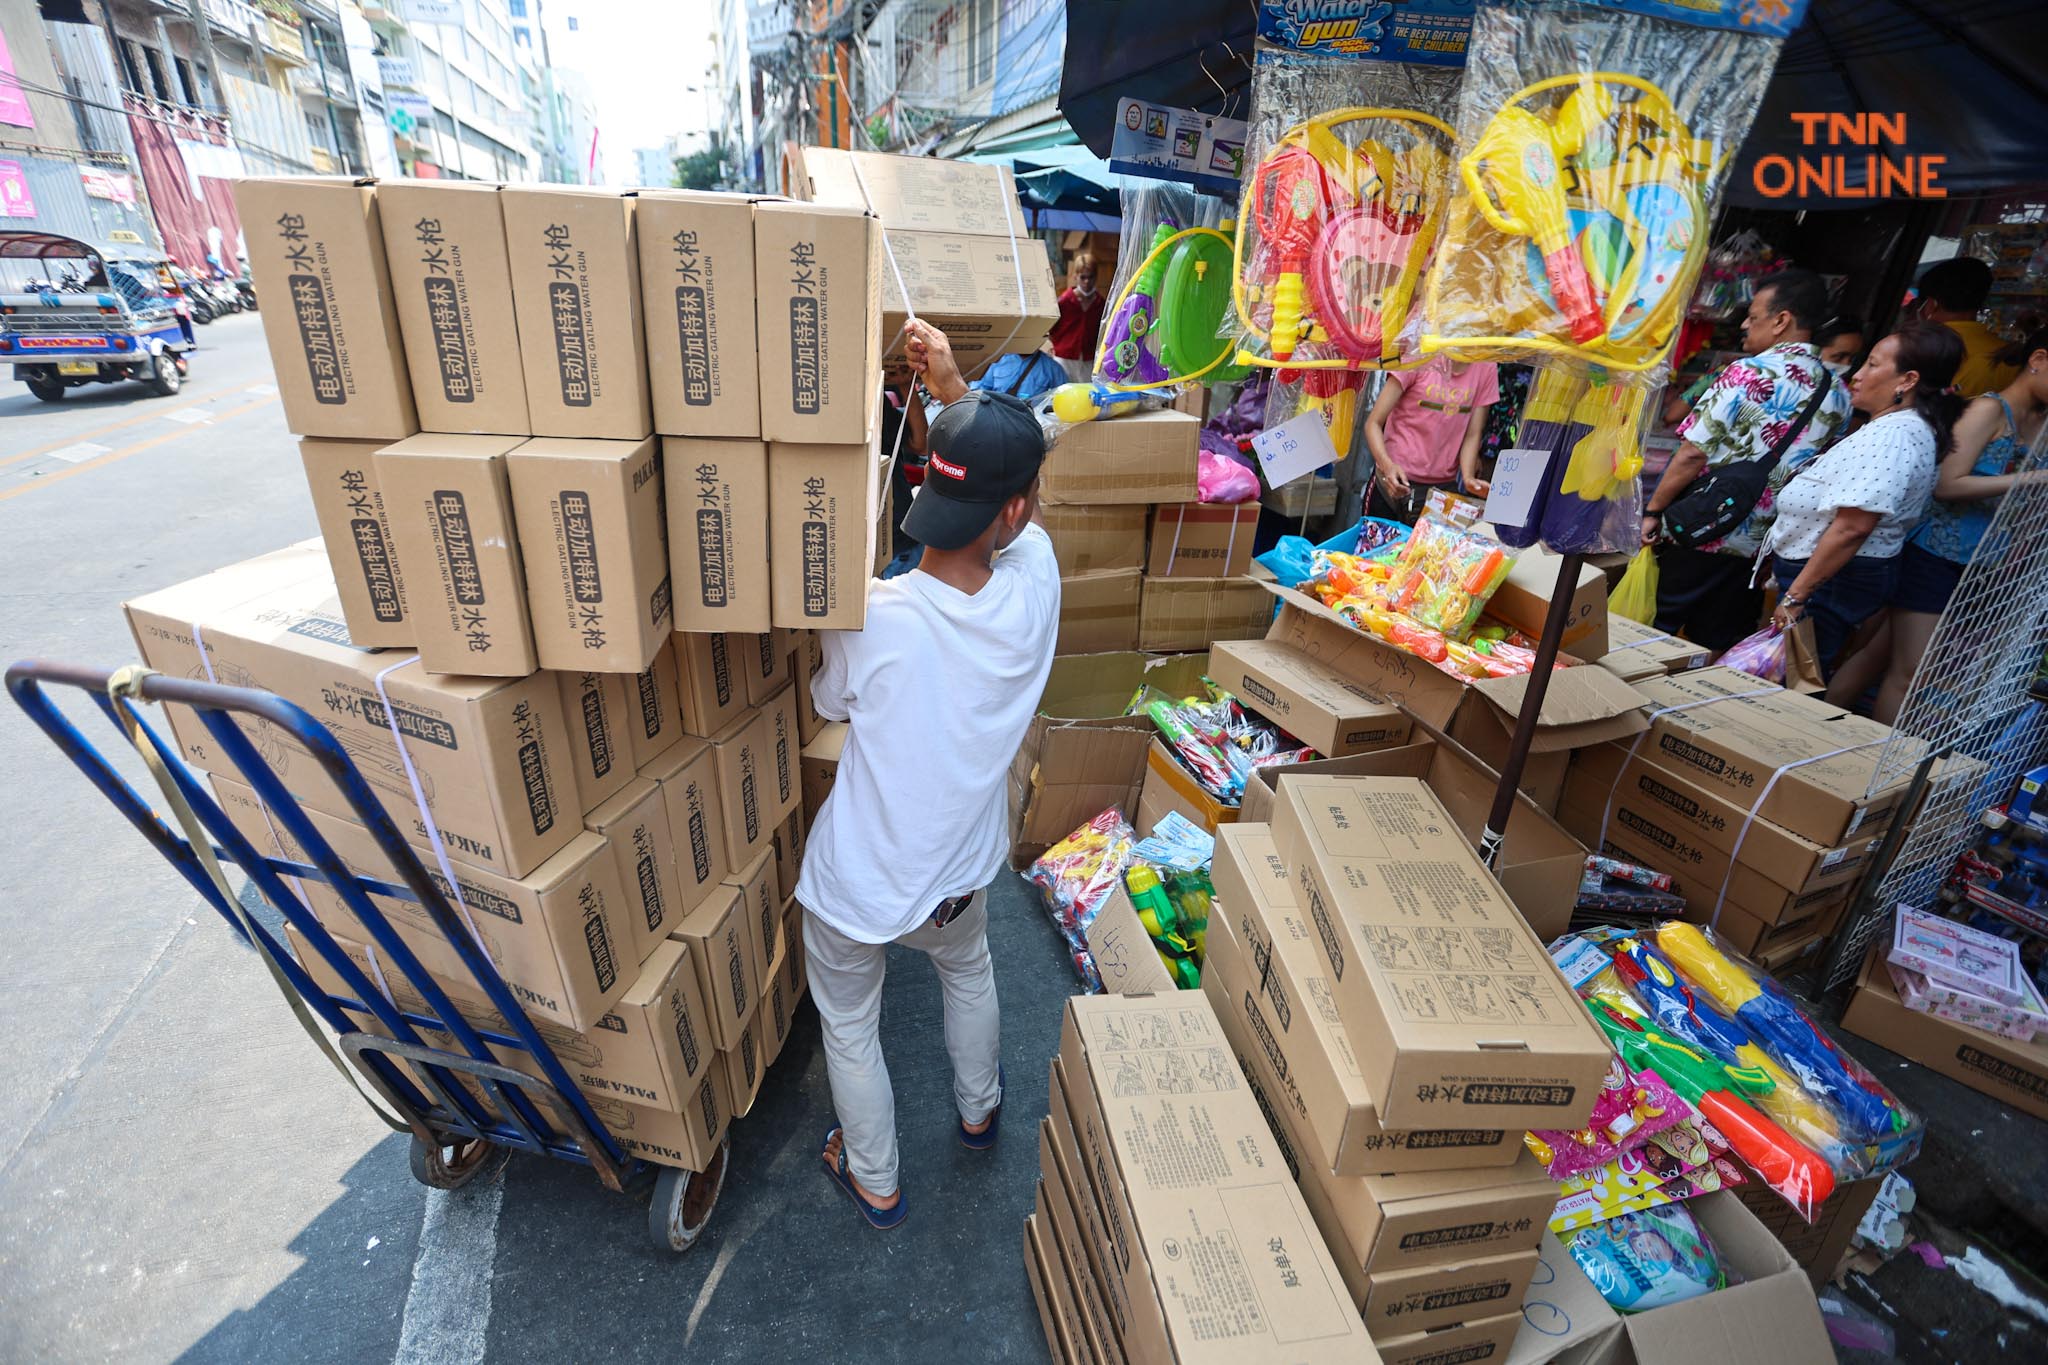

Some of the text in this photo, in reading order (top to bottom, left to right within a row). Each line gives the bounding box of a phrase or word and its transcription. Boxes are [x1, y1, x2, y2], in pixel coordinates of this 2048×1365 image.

[1300, 19, 1358, 45] gun
[1331, 39, 1365, 47] BACK
[1340, 44, 1371, 53] PACK
[1394, 26, 1469, 42] THE BEST GIFT FOR
[1408, 38, 1424, 49] THE
[277, 213, 341, 398] 电动加特林水枪
[415, 217, 469, 396] 电动加特林水枪
[544, 224, 587, 400] 电动加特林水枪
[673, 230, 707, 400] 电动加特林水枪
[790, 241, 816, 408] 电动加特林水枪
[1282, 440, 1297, 453] 150
[340, 470, 397, 617] 电动加特林水枪
[695, 463, 724, 602] 电动加特林水枪
[803, 476, 826, 612] 电动加特林水枪
[438, 496, 492, 653] 电动加特林水枪
[564, 496, 606, 650] 电动加特林水枪
[512, 700, 551, 830] 电动加特林水枪
[1664, 737, 1755, 788] 电动加特林水枪
[1328, 806, 1350, 830] 贴单处
[1417, 1084, 1569, 1104] 电动加特林水枪
[1569, 1196, 1593, 1208] WATER
[1266, 1236, 1302, 1288] 贴单处
[1613, 1247, 1654, 1291] BUZZ
